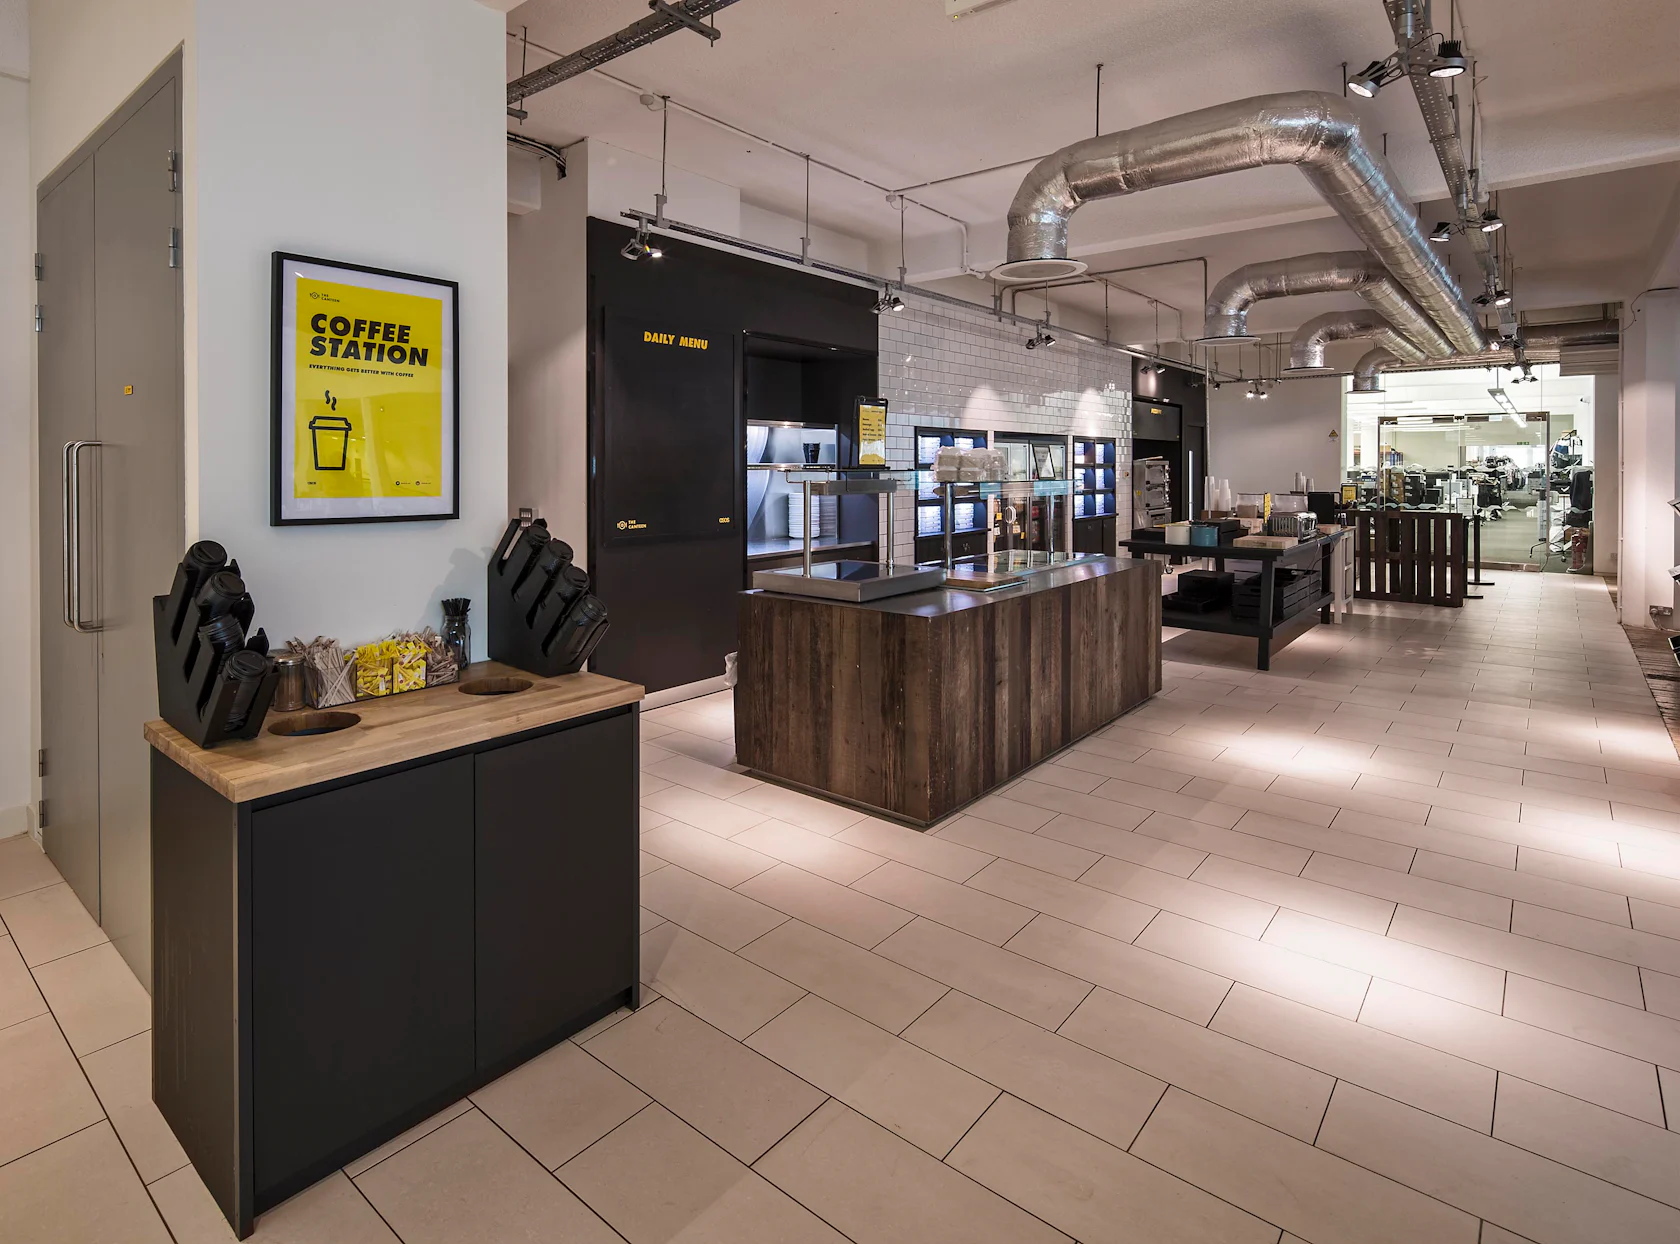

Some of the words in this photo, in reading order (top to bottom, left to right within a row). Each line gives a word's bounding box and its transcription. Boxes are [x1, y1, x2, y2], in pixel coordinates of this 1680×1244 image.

[310, 313, 411, 344] COFFEE
[643, 331, 675, 345] DAILY
[679, 336, 708, 350] MENU
[309, 335, 429, 367] STATION
[309, 364, 345, 372] EVERYTHING
